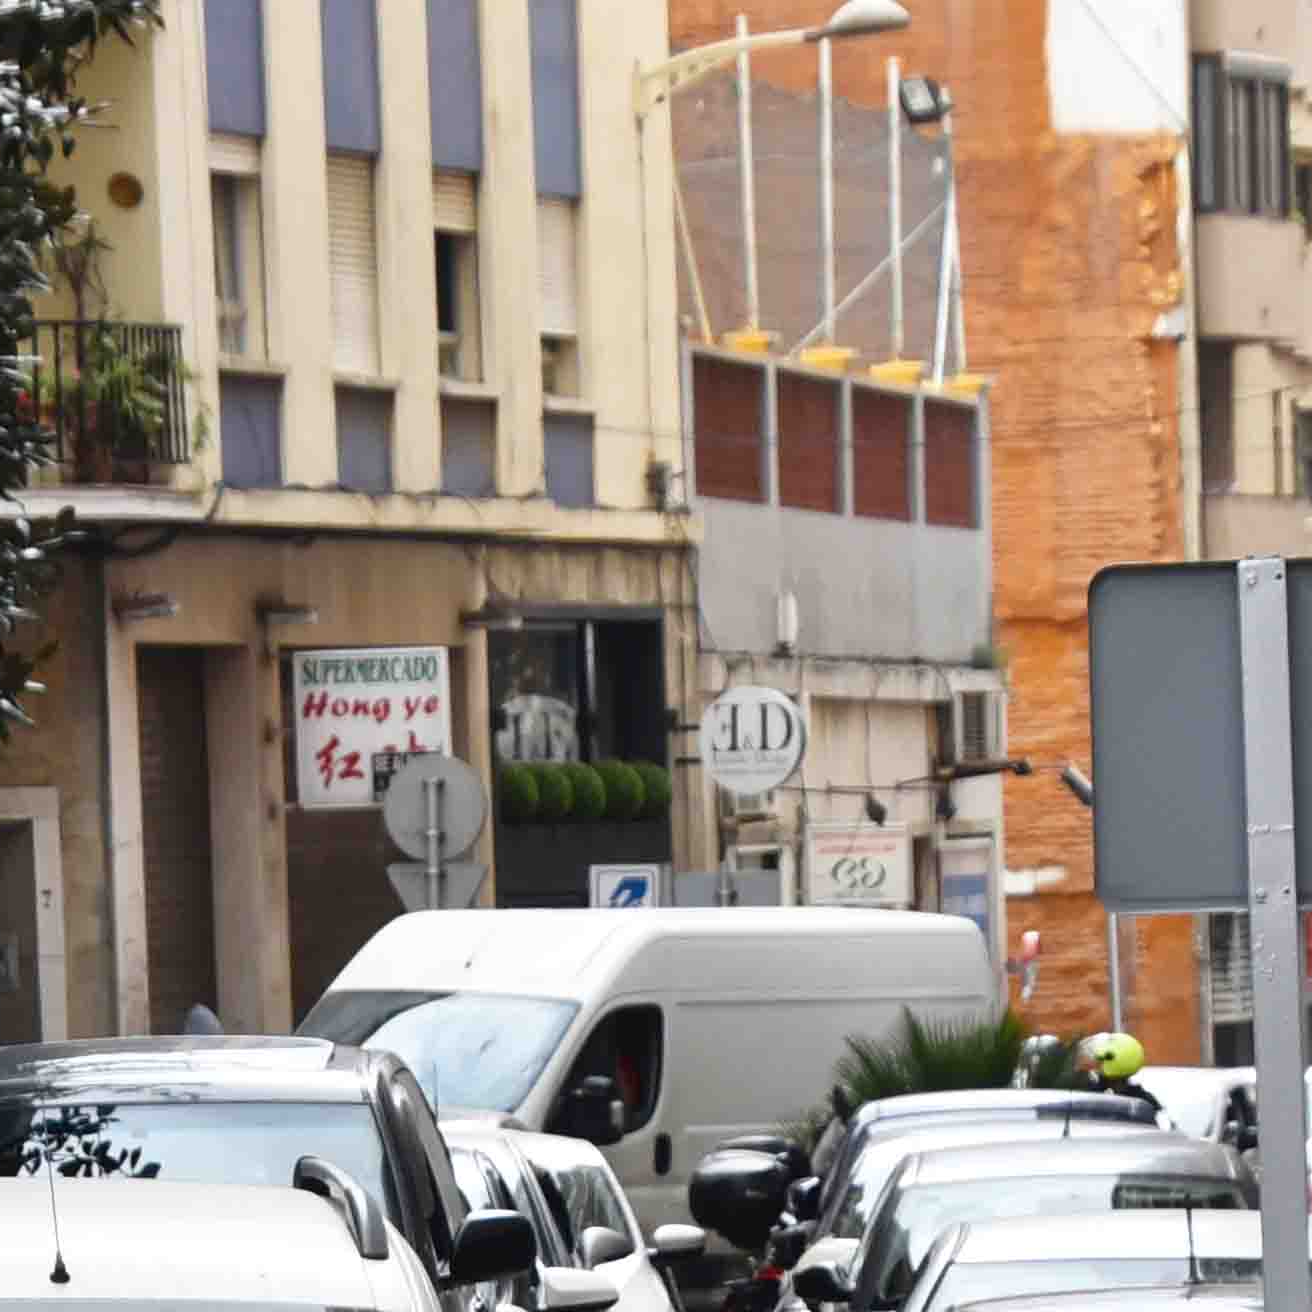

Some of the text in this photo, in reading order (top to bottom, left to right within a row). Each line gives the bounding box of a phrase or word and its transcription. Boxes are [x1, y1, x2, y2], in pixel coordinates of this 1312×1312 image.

[302, 655, 439, 686] SUPERMERCADO
[302, 691, 440, 724] Hong ye
